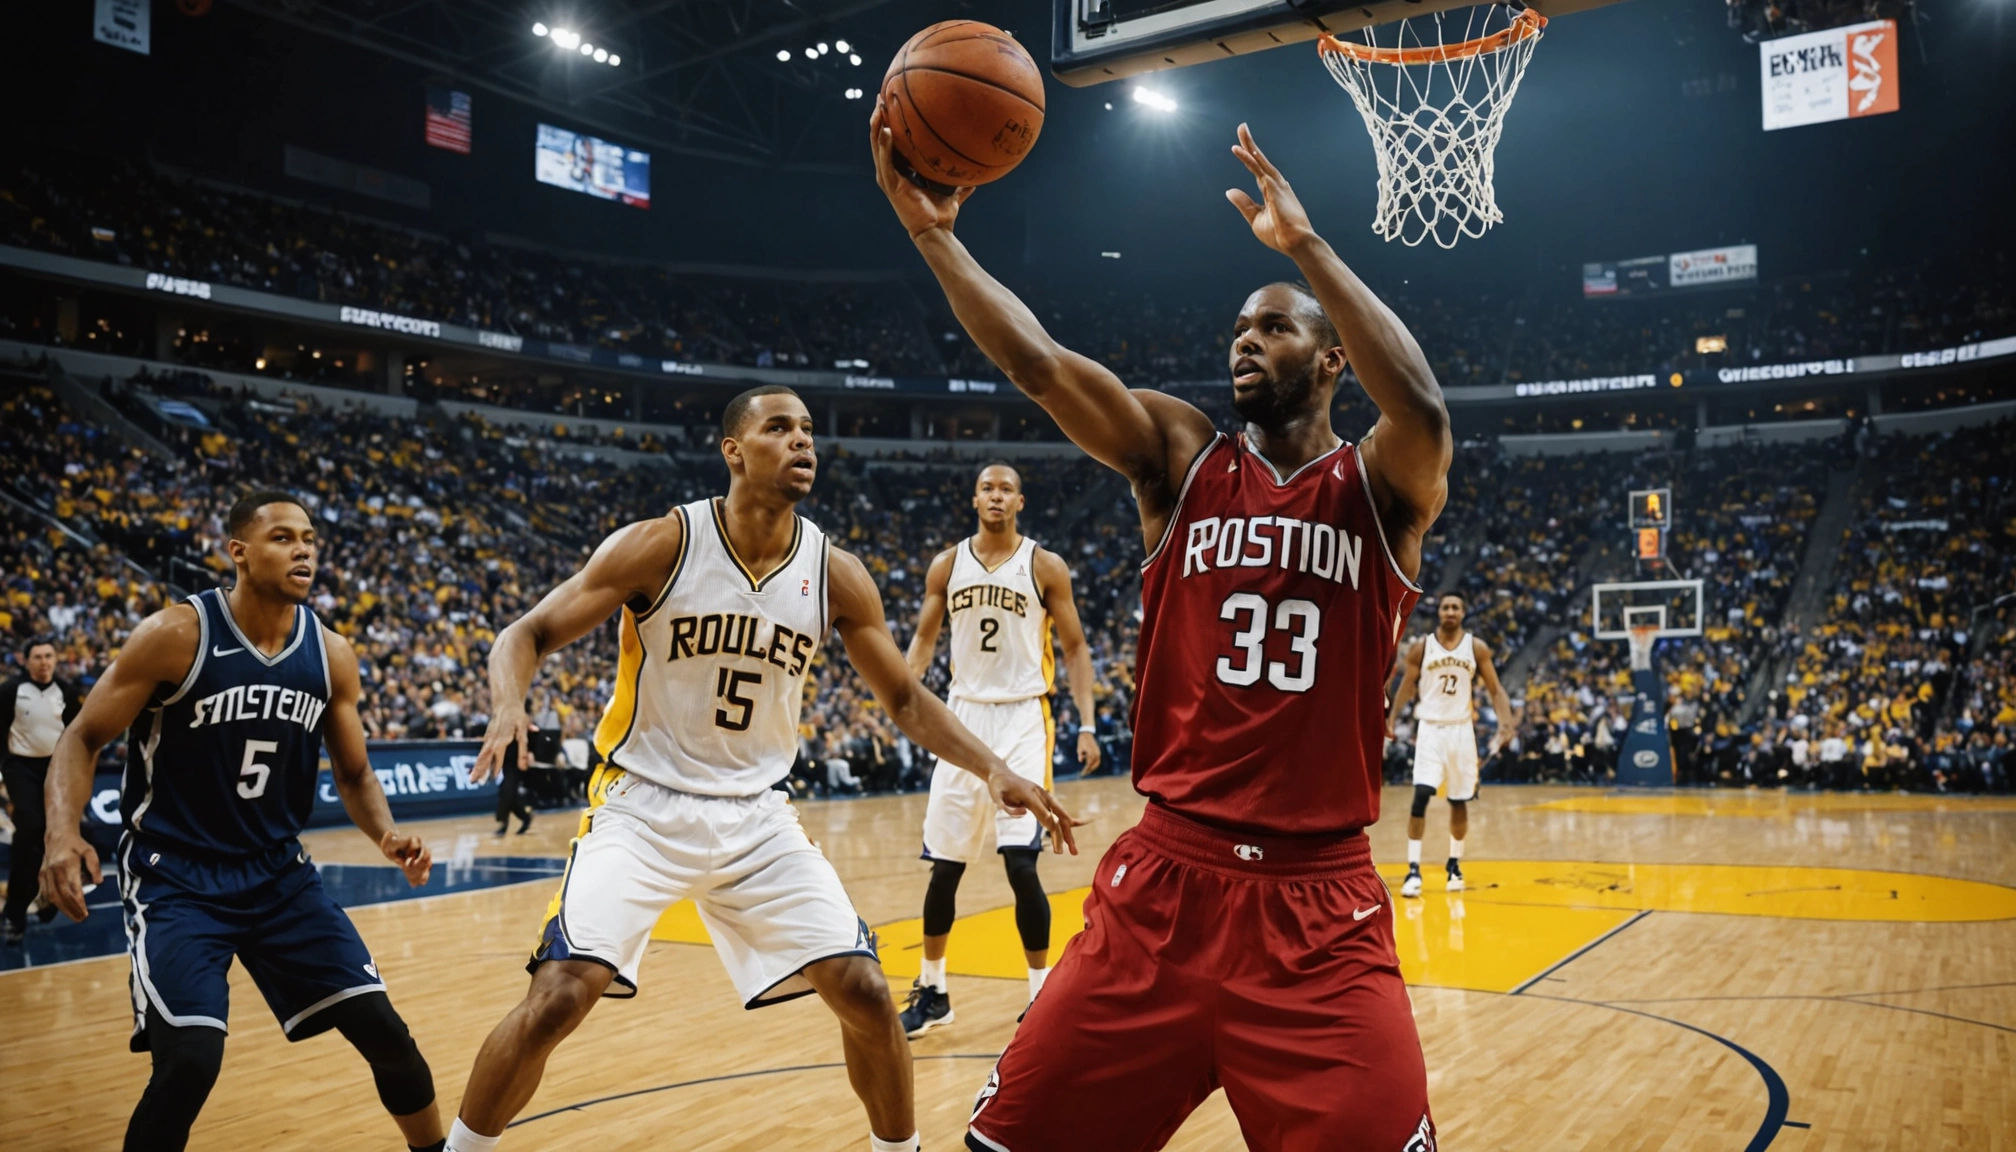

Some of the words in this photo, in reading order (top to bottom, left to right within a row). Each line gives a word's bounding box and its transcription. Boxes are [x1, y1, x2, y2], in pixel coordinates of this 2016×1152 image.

[667, 613, 814, 677] ROULES
[980, 617, 999, 652] 2
[1215, 591, 1321, 693] 33
[236, 738, 279, 800] 5
